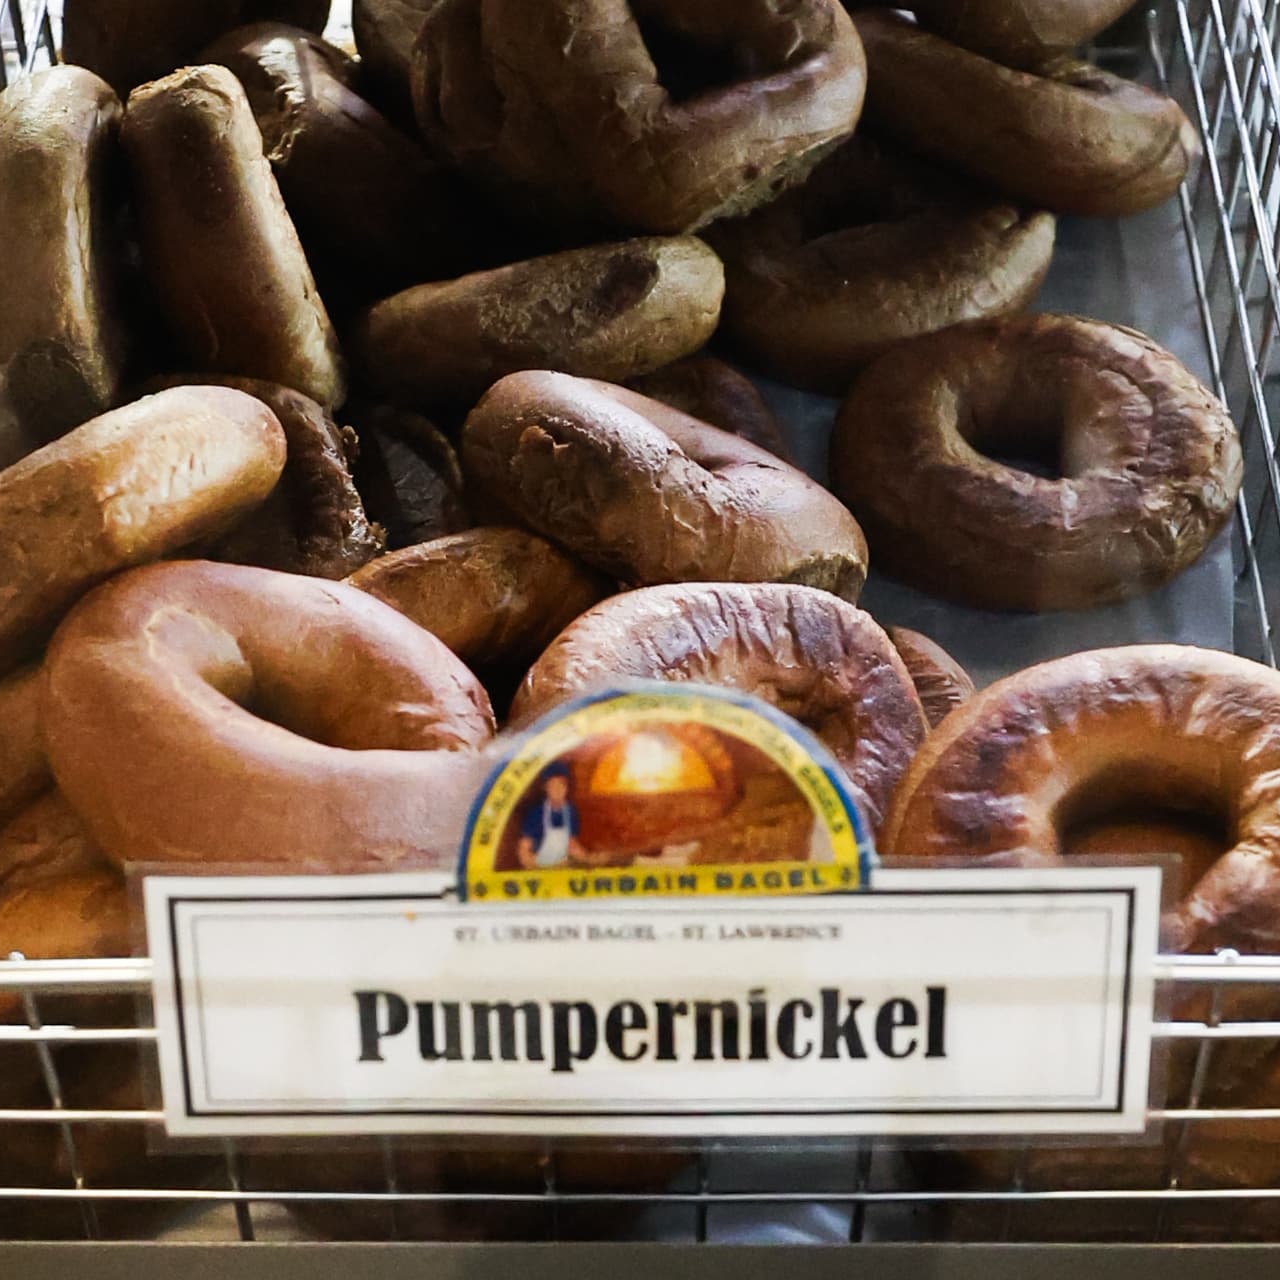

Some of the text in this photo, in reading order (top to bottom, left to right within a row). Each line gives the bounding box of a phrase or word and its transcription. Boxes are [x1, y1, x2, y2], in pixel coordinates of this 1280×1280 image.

[569, 873, 698, 896] URBAIN
[715, 868, 826, 891] BAGEL
[352, 985, 948, 1072] Pumpernickel
